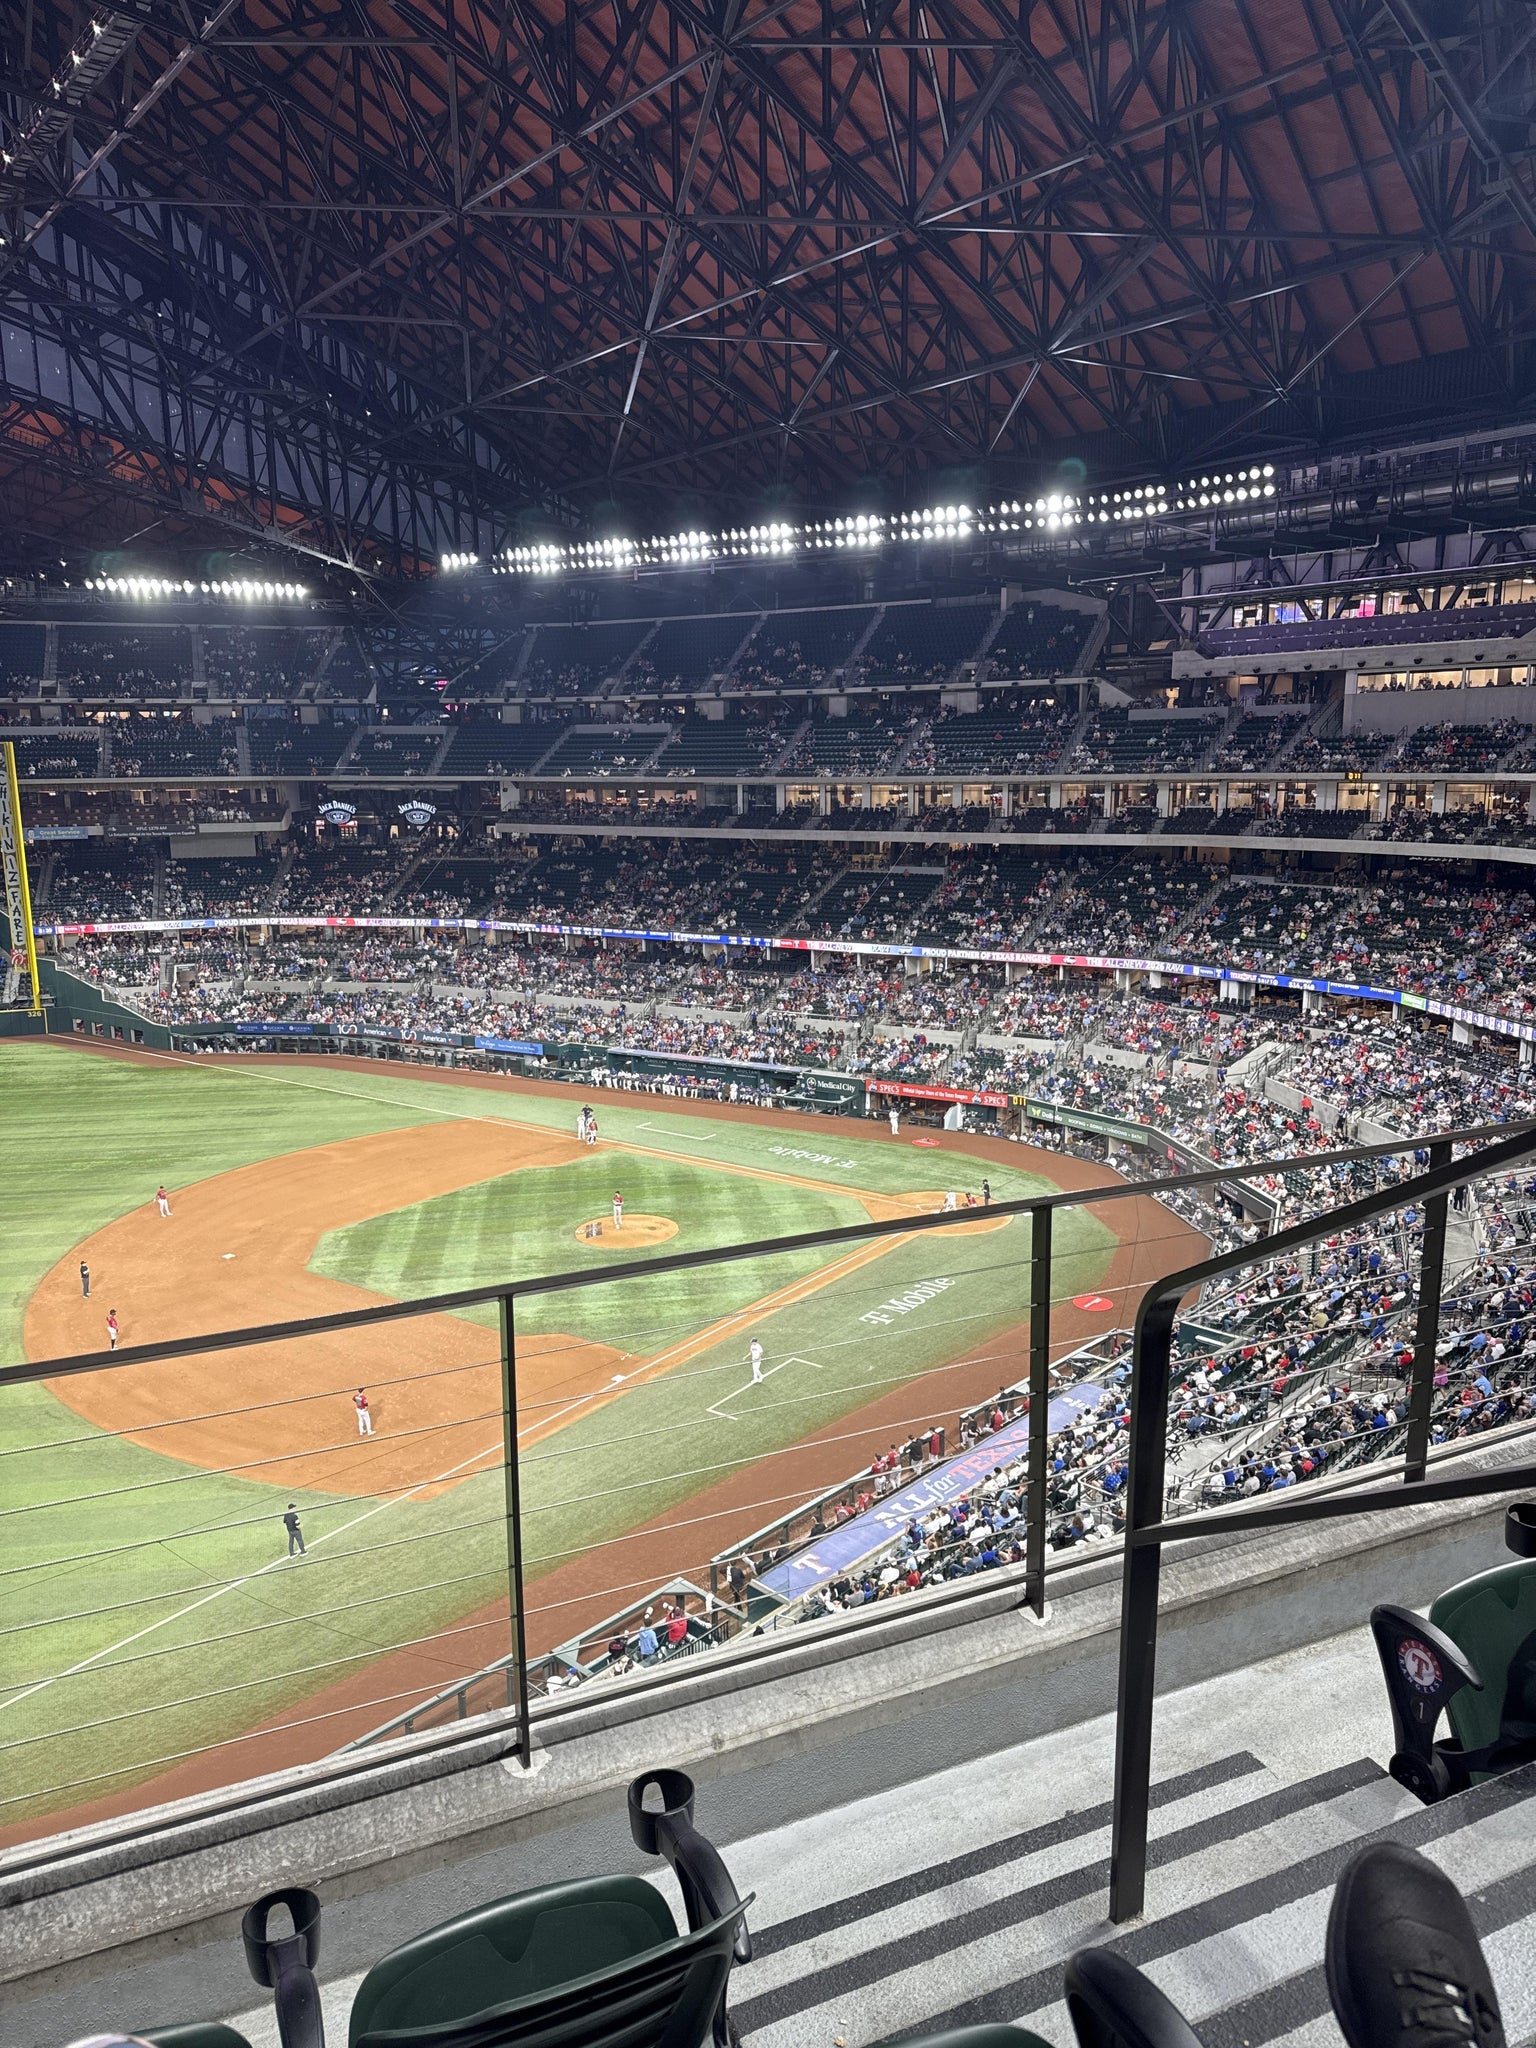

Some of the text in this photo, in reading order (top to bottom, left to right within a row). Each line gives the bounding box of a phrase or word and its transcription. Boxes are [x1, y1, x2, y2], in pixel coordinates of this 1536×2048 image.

[318, 800, 357, 814] JACK DANIEL'S
[398, 800, 437, 814] JACK DANIEL'S
[11, 891, 23, 942] FARE
[922, 948, 1051, 963] PROUD PARTNER OF TEXAS RANGERS
[1104, 959, 1143, 969] ALL-NEW
[1145, 961, 1164, 970] 2026
[1165, 964, 1184, 973] RAV4
[363, 1028, 387, 1036] American
[422, 1034, 447, 1043] American
[817, 1080, 856, 1093] Medical City
[879, 1084, 900, 1093] SPEC'S
[983, 1095, 1006, 1105] SPEC'S
[768, 1145, 840, 1165] Mobile
[885, 1276, 956, 1316] Mobile
[873, 1490, 931, 1529] ALL
[922, 1472, 960, 1497] for
[791, 1552, 832, 1576] T
[1411, 1652, 1430, 1681] T
[1399, 1658, 1440, 1693] RANGERS
[1418, 1701, 1424, 1720] 1
